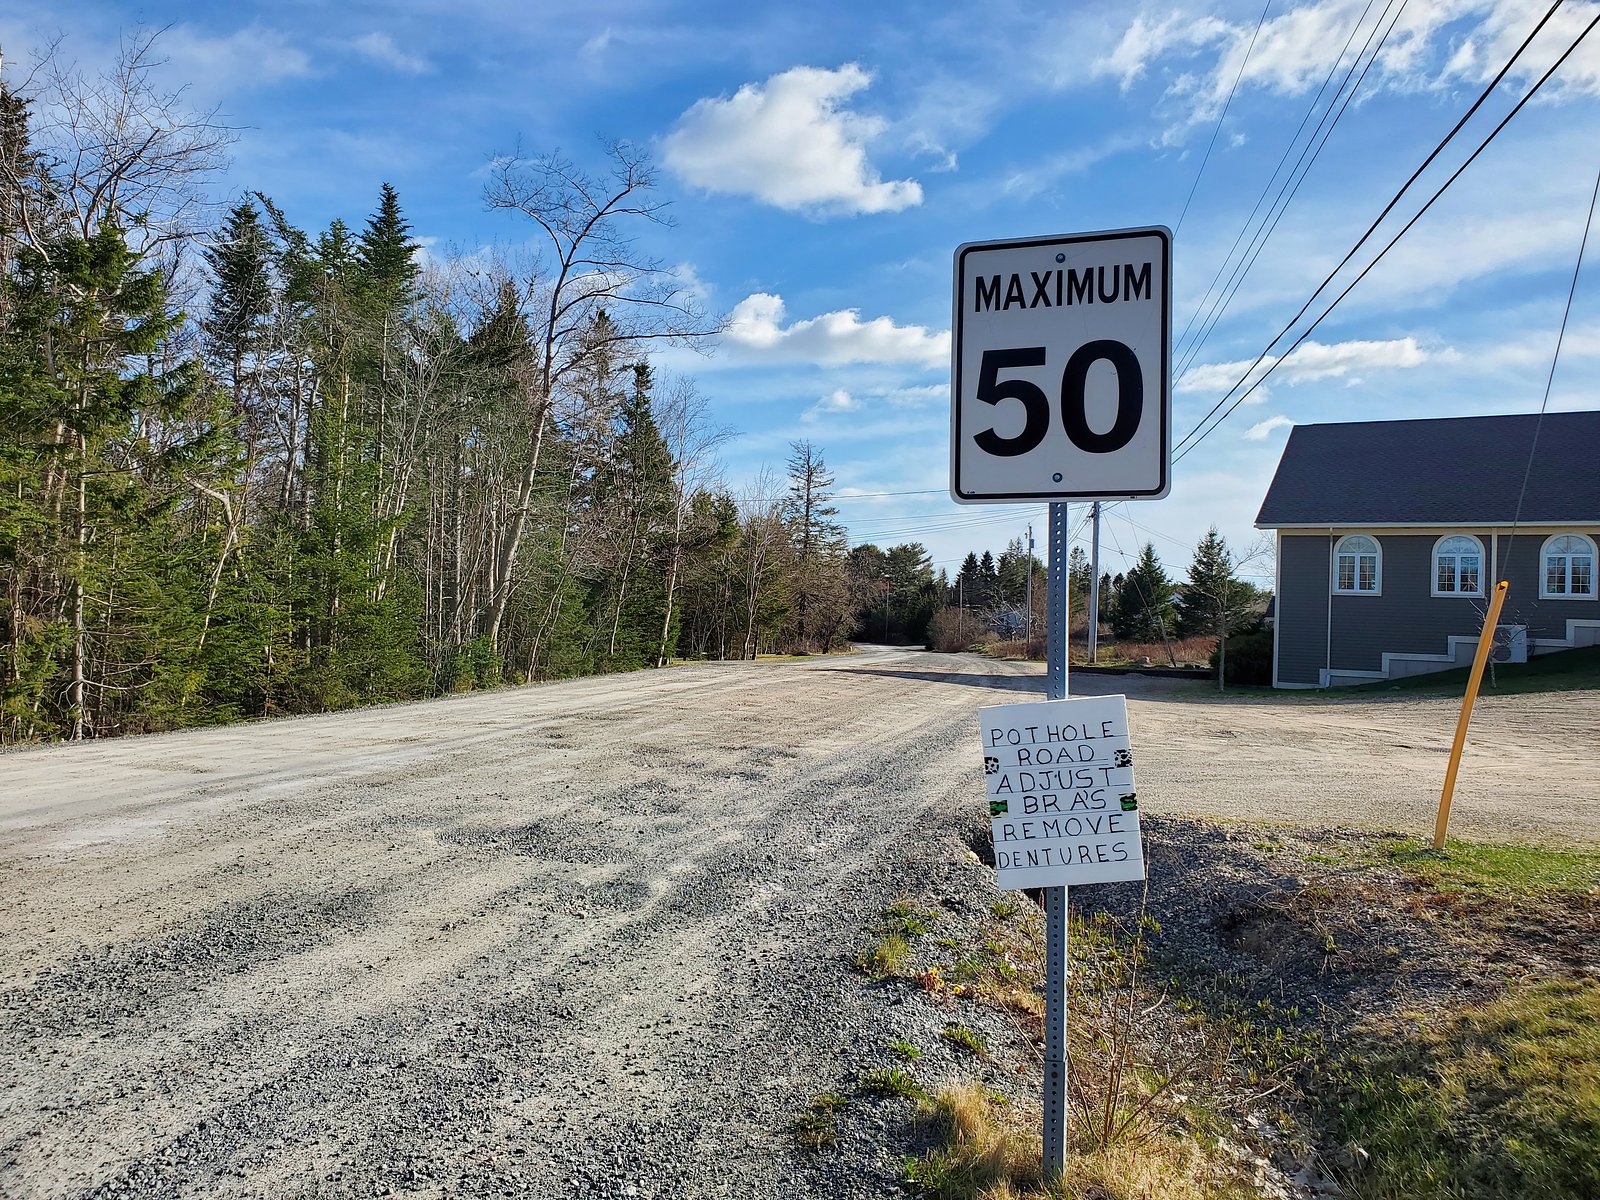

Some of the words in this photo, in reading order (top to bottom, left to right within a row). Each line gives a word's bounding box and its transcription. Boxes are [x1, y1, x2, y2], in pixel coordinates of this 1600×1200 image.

[975, 262, 1152, 313] MAXIMUM
[973, 339, 1143, 457] 50
[1018, 744, 1095, 766] ROAD
[996, 767, 1115, 794] ADJUST
[1003, 814, 1125, 841] REMOVE
[999, 842, 1128, 869] DENTURES
